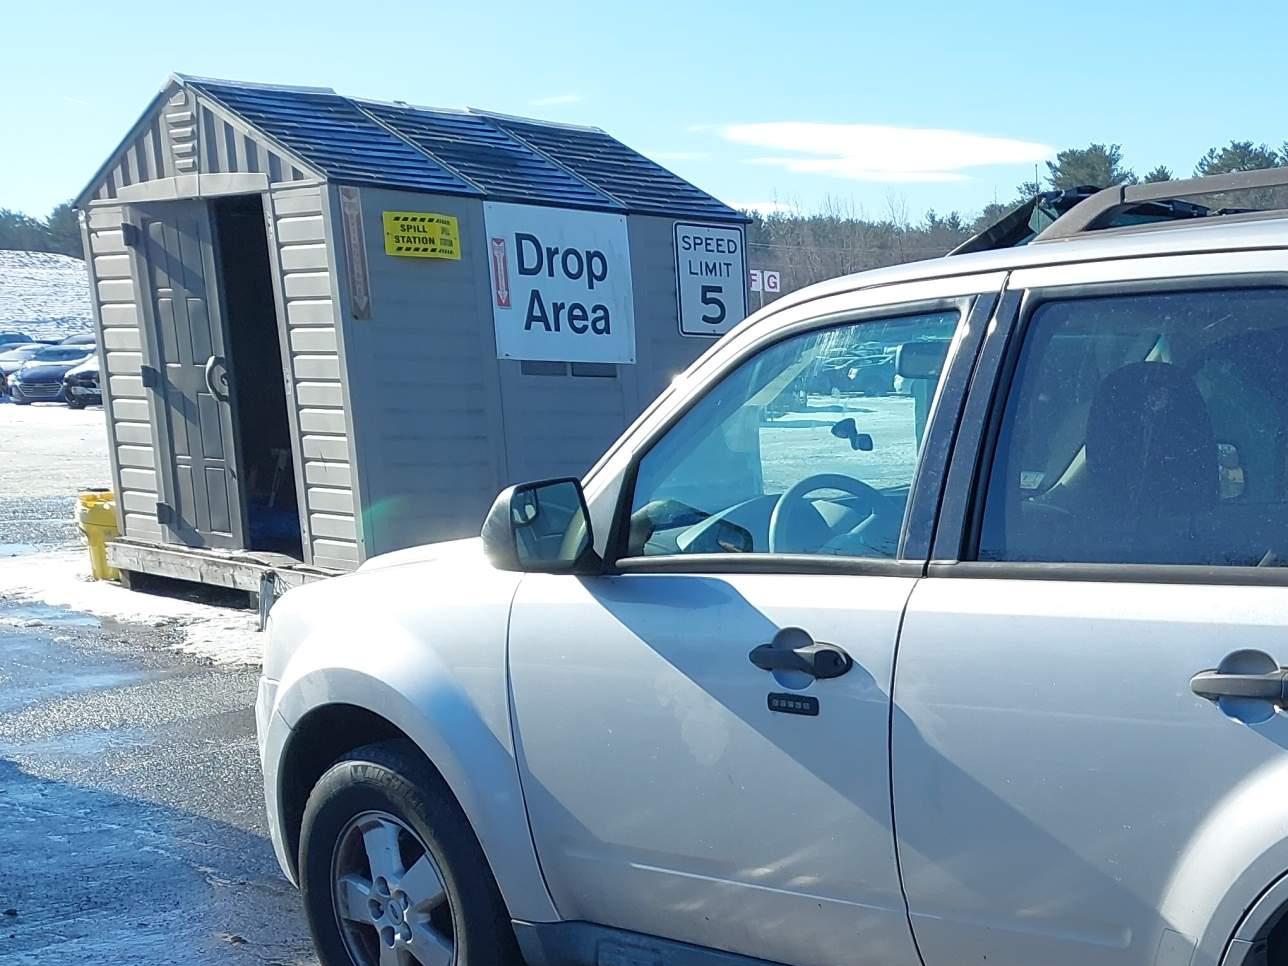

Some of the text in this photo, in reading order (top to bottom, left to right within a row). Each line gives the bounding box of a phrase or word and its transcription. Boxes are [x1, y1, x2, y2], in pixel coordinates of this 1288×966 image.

[400, 224, 428, 234] SPILL
[394, 235, 435, 245] STATION
[681, 235, 738, 254] SPEED
[514, 232, 608, 290] Drop
[688, 259, 732, 278] LIMIT
[749, 273, 758, 289] F
[767, 274, 778, 290] G
[524, 289, 611, 335] Area
[701, 285, 726, 325] 5
